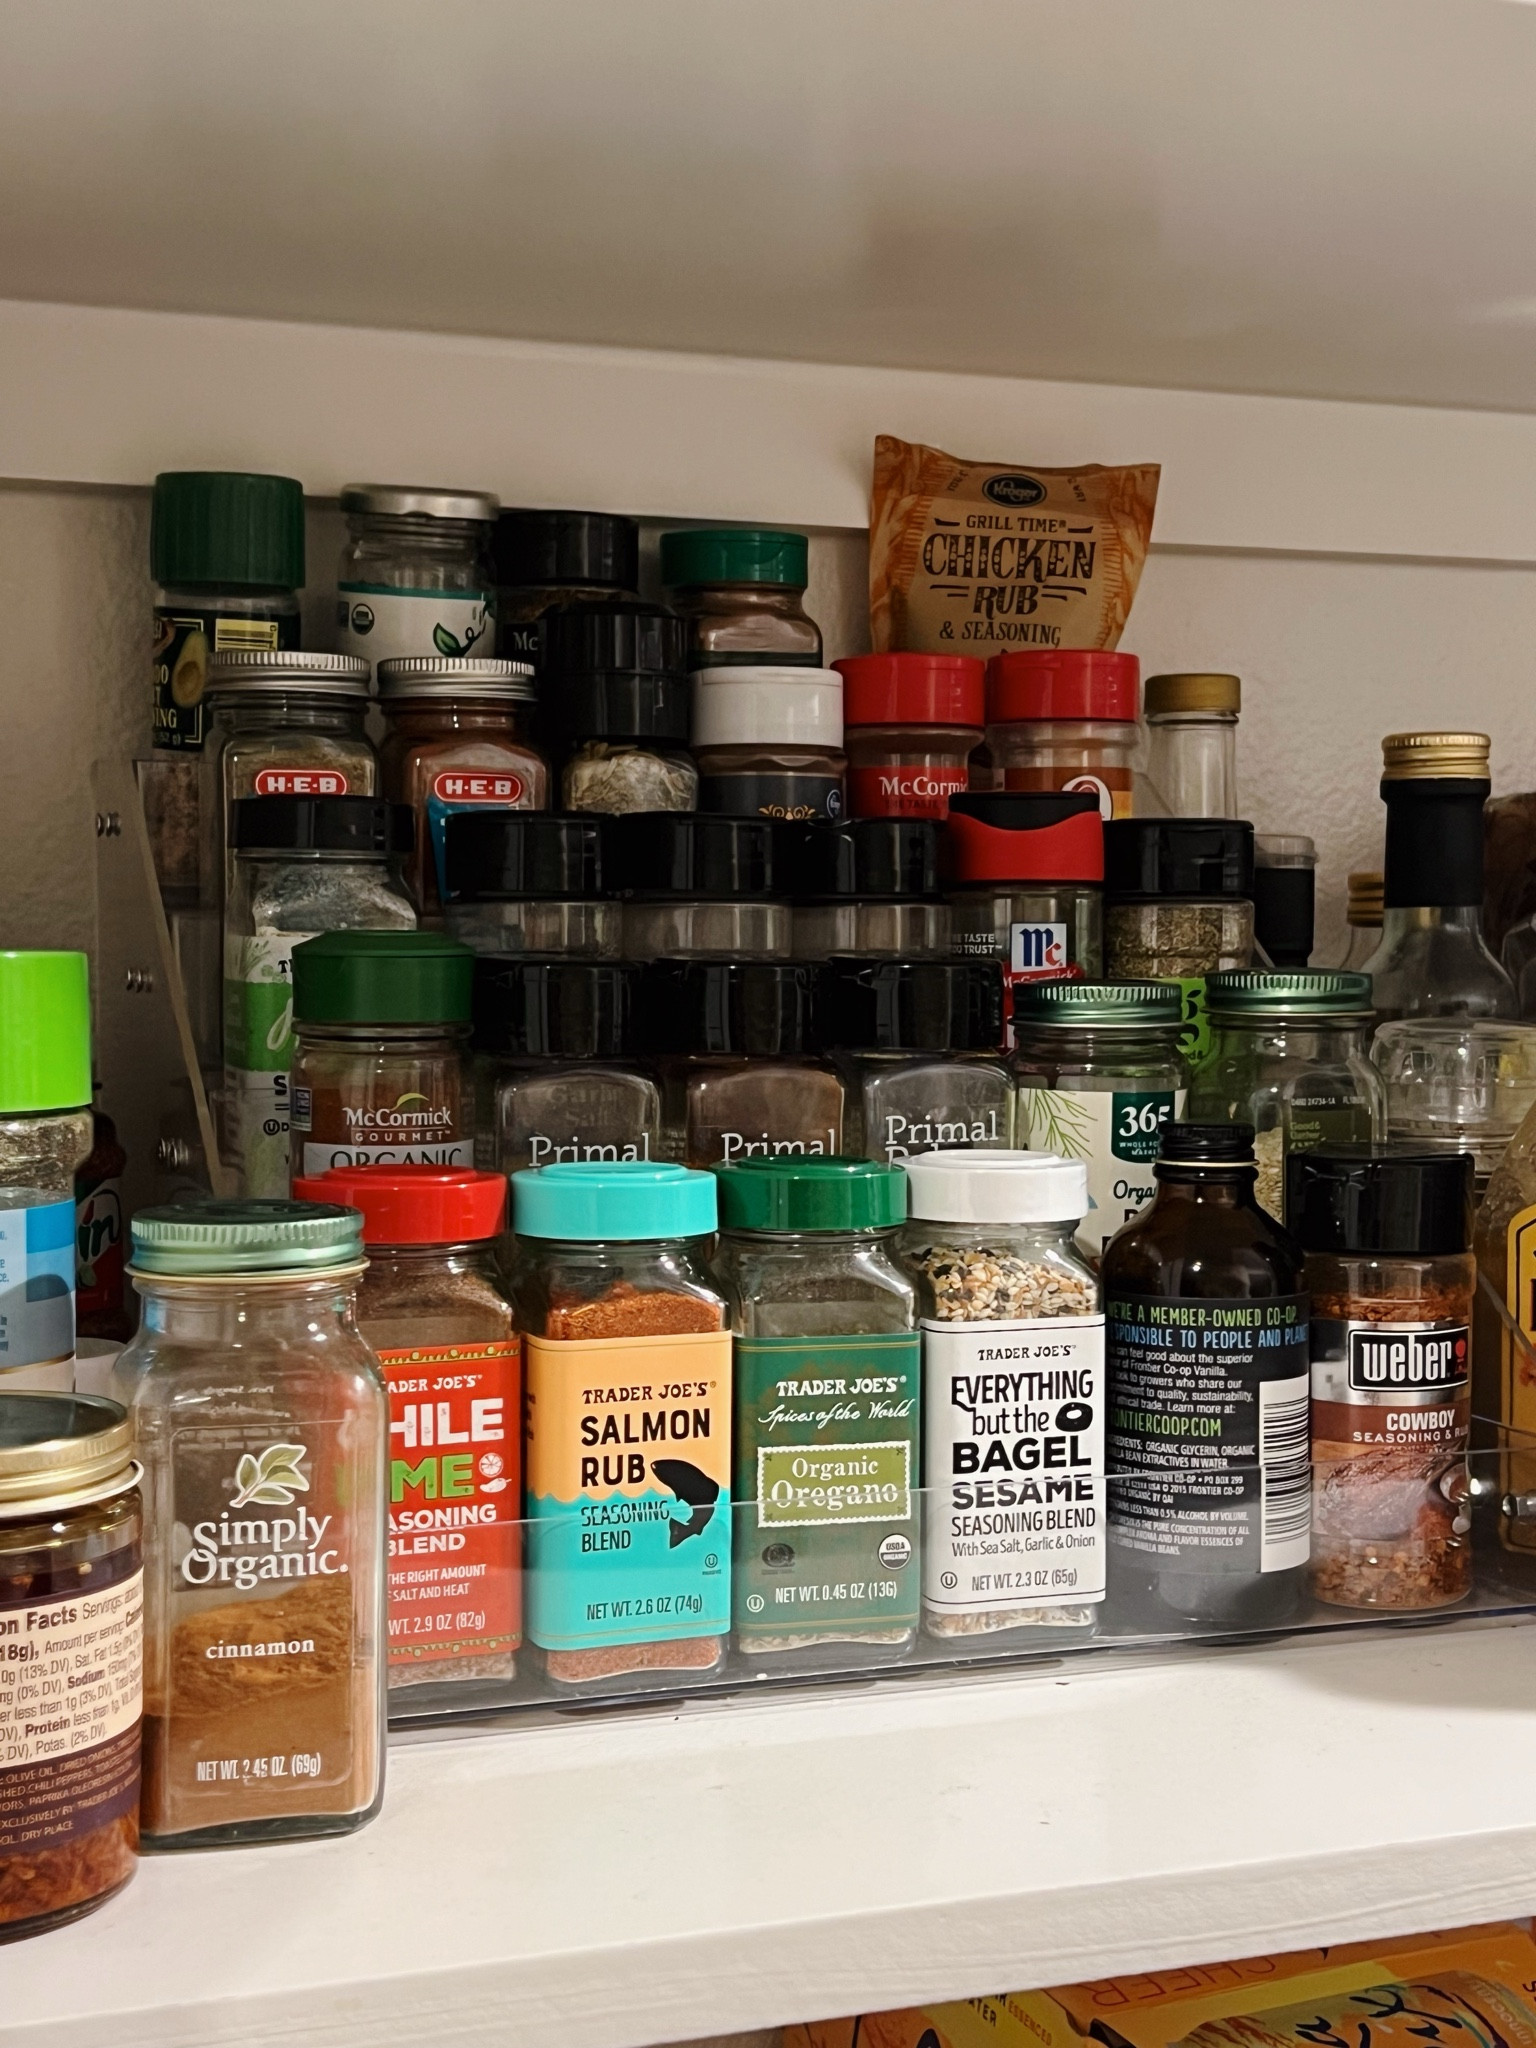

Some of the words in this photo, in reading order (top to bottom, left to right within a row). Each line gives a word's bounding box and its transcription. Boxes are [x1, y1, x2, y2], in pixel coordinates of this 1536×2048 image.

[993, 480, 1039, 502] Kroger
[966, 515, 1013, 530] GRILL
[923, 533, 1096, 582] CHICKEN
[973, 586, 1038, 619] RUB
[939, 621, 955, 639] &
[962, 622, 1061, 648] SEASONING
[964, 933, 995, 943] TASTE
[342, 1106, 453, 1127] McCormick
[885, 1111, 999, 1145] Primal
[528, 1132, 649, 1167] Primal
[721, 1129, 835, 1168] Primal
[1137, 1304, 1145, 1323] A
[1151, 1305, 1262, 1327] MEMBER-OWNED
[1179, 1330, 1197, 1348] TO
[1203, 1331, 1252, 1349] PEOPLE
[1258, 1328, 1281, 1348] AND
[977, 1347, 1030, 1361] TRADER
[1033, 1345, 1071, 1359] JOE'S
[1145, 1351, 1167, 1361] good
[1169, 1352, 1196, 1363] about
[1198, 1353, 1214, 1363] the
[1216, 1353, 1253, 1364] superior
[1361, 1334, 1452, 1382] weber
[1163, 1363, 1192, 1376] Co-op
[432, 1374, 477, 1391] JOE'S
[582, 1386, 653, 1405] TRADER
[658, 1381, 708, 1399] JOE'S
[776, 1379, 846, 1397] TRADER
[849, 1376, 899, 1394] JOE'S
[951, 1369, 1094, 1405] EVERYTHING
[1139, 1374, 1173, 1387] growers
[1175, 1378, 1195, 1388] who
[1198, 1379, 1224, 1389] share
[1227, 1380, 1243, 1389] our
[1146, 1387, 1155, 1397] to
[758, 1404, 814, 1432] Spices
[815, 1402, 843, 1429] of
[834, 1402, 861, 1420] the
[868, 1398, 916, 1419] World
[1167, 1402, 1194, 1413] Learn
[1196, 1404, 1221, 1413] more
[580, 1408, 711, 1447] SALMON
[972, 1405, 1011, 1436] but
[1012, 1404, 1050, 1433] the
[1386, 1409, 1456, 1431] COWBOY
[1353, 1430, 1441, 1443] SEASONING
[1445, 1429, 1452, 1440] &
[952, 1435, 1092, 1474] BAGEL
[1142, 1453, 1189, 1468] EXTRACTIVES
[1190, 1457, 1200, 1468] IN
[581, 1454, 646, 1488] RUB
[792, 1456, 878, 1480] Organic
[767, 1480, 899, 1511] Oregano
[951, 1473, 1094, 1510] SESAME
[581, 1500, 670, 1527] SEASONING
[951, 1510, 1043, 1537] SEASONING
[1046, 1507, 1096, 1530] BLEND
[193, 1506, 332, 1554] Simply
[581, 1530, 631, 1552] BLEND
[886, 1542, 905, 1551] USDA
[952, 1541, 979, 1558] With
[980, 1540, 999, 1555] Sea
[1000, 1538, 1024, 1555] Salt,
[1025, 1535, 1054, 1552] Garlic
[1055, 1535, 1064, 1550] &
[1065, 1533, 1096, 1549] Onion
[407, 1569, 440, 1583] RIGHT
[440, 1564, 487, 1579] AMOUNT
[972, 1574, 991, 1591] NET
[993, 1573, 1014, 1589] WT.
[1015, 1572, 1032, 1588] 2.3
[1034, 1570, 1049, 1587] OZ
[1051, 1567, 1078, 1588] (65g)
[393, 1588, 418, 1602] SALT
[419, 1586, 441, 1600] AND
[443, 1583, 470, 1597] HEAT
[775, 1586, 797, 1604] NET
[799, 1585, 820, 1602] WT.
[822, 1584, 846, 1600] 0.45
[850, 1583, 865, 1598] OZ
[868, 1581, 898, 1600] (13G)
[587, 1602, 609, 1620] NET
[611, 1600, 633, 1618] WT.
[636, 1598, 653, 1615] 2.6
[656, 1596, 672, 1613] OZ
[675, 1593, 703, 1614] (74g)
[26, 1606, 77, 1632] Facts
[414, 1616, 433, 1633] 2.9
[436, 1614, 453, 1630] OZ
[456, 1610, 486, 1631] (82g)
[44, 1634, 82, 1654] Amount
[84, 1631, 98, 1648] per
[206, 1639, 315, 1659] cinnamon
[17, 1685, 40, 1702] (0%
[68, 1669, 105, 1690] Sodium
[20, 1664, 48, 1684] (13%
[15, 1707, 37, 1721] less
[40, 1701, 62, 1716] than
[66, 1696, 77, 1712] 1g
[25, 1716, 71, 1739] Protein
[7, 1743, 33, 1761] DV),
[70, 1731, 89, 1749] (2%
[5, 1768, 36, 1784] OLIVE
[197, 1760, 219, 1781] NET
[291, 1752, 321, 1777] (69g)
